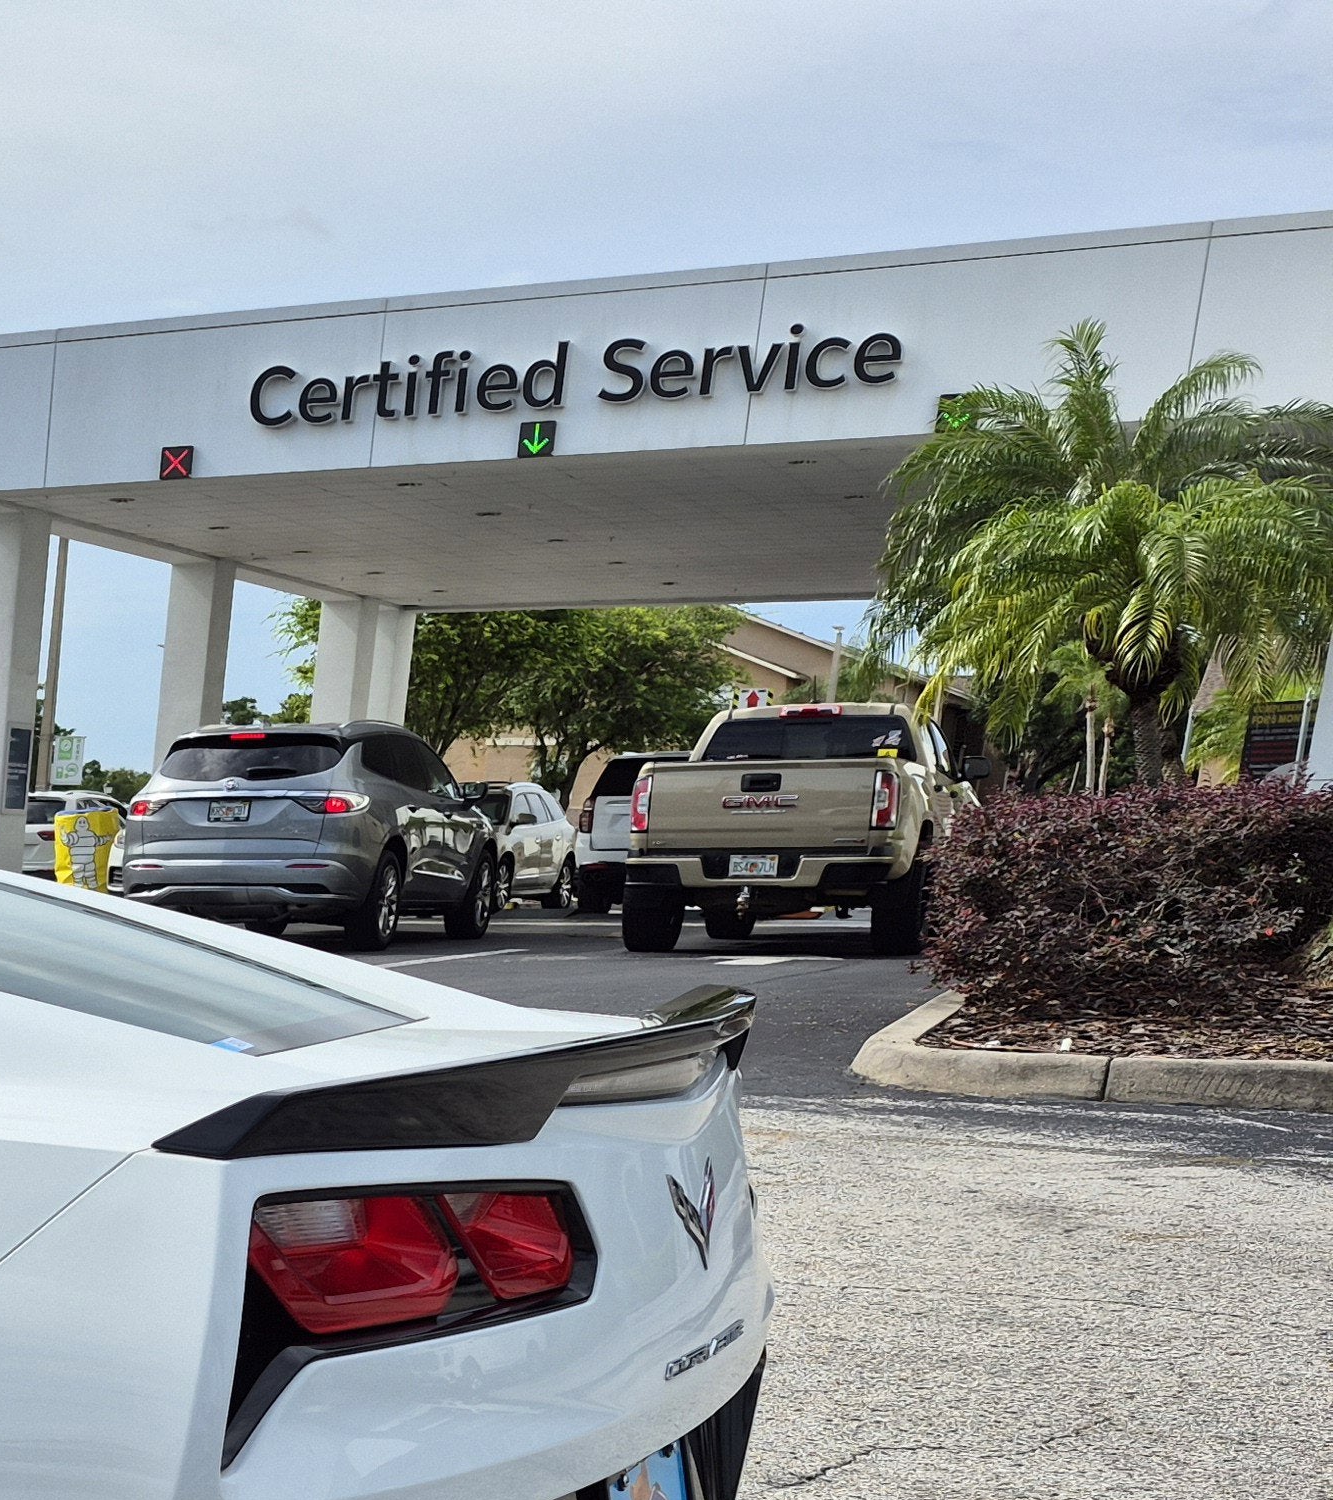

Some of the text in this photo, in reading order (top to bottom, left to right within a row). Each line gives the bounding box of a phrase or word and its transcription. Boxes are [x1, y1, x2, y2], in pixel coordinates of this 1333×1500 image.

[249, 323, 904, 427] Certified Service
[722, 794, 800, 809] GMC
